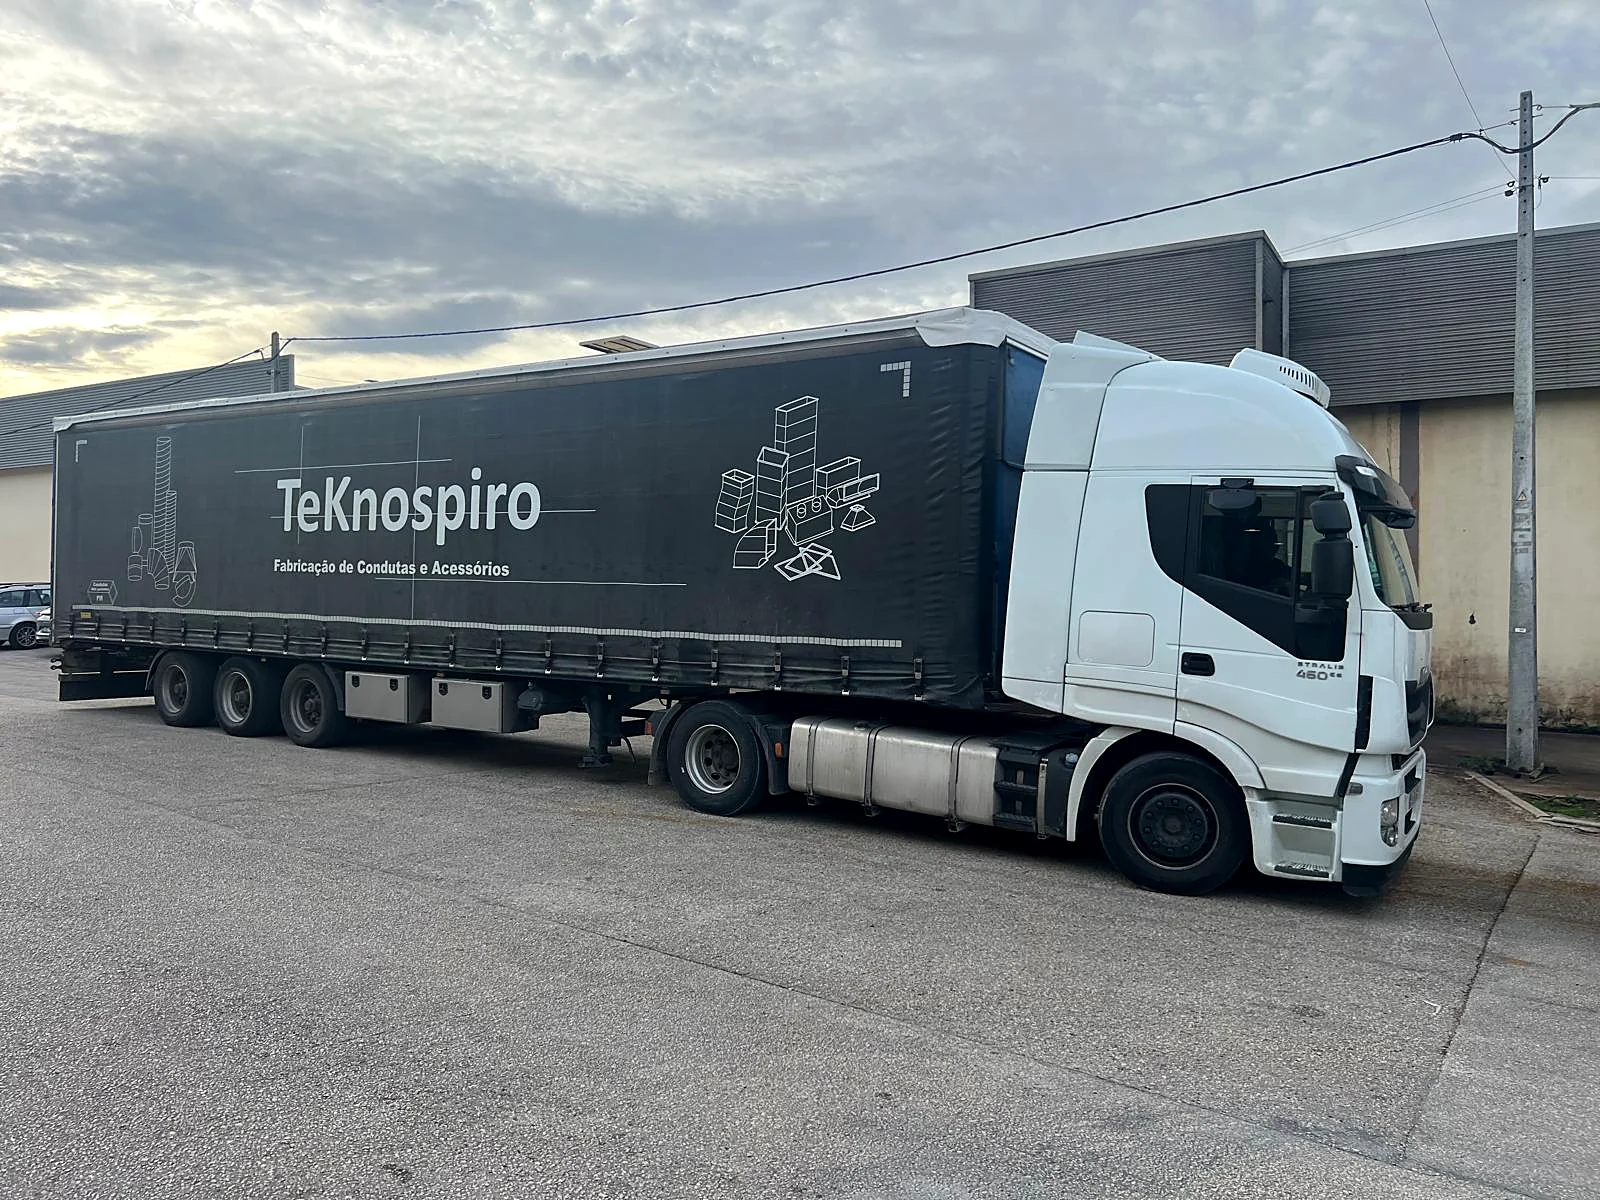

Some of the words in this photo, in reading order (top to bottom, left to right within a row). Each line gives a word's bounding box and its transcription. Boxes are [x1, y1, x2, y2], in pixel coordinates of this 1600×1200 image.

[277, 467, 541, 546] TeKnospiro
[274, 558, 336, 577] Fabricação
[338, 559, 354, 574] de
[357, 560, 416, 576] Condutas
[419, 564, 428, 575] e
[431, 560, 510, 577] Acessórios
[1297, 661, 1344, 669] STRALIS
[1296, 670, 1328, 680] 460
